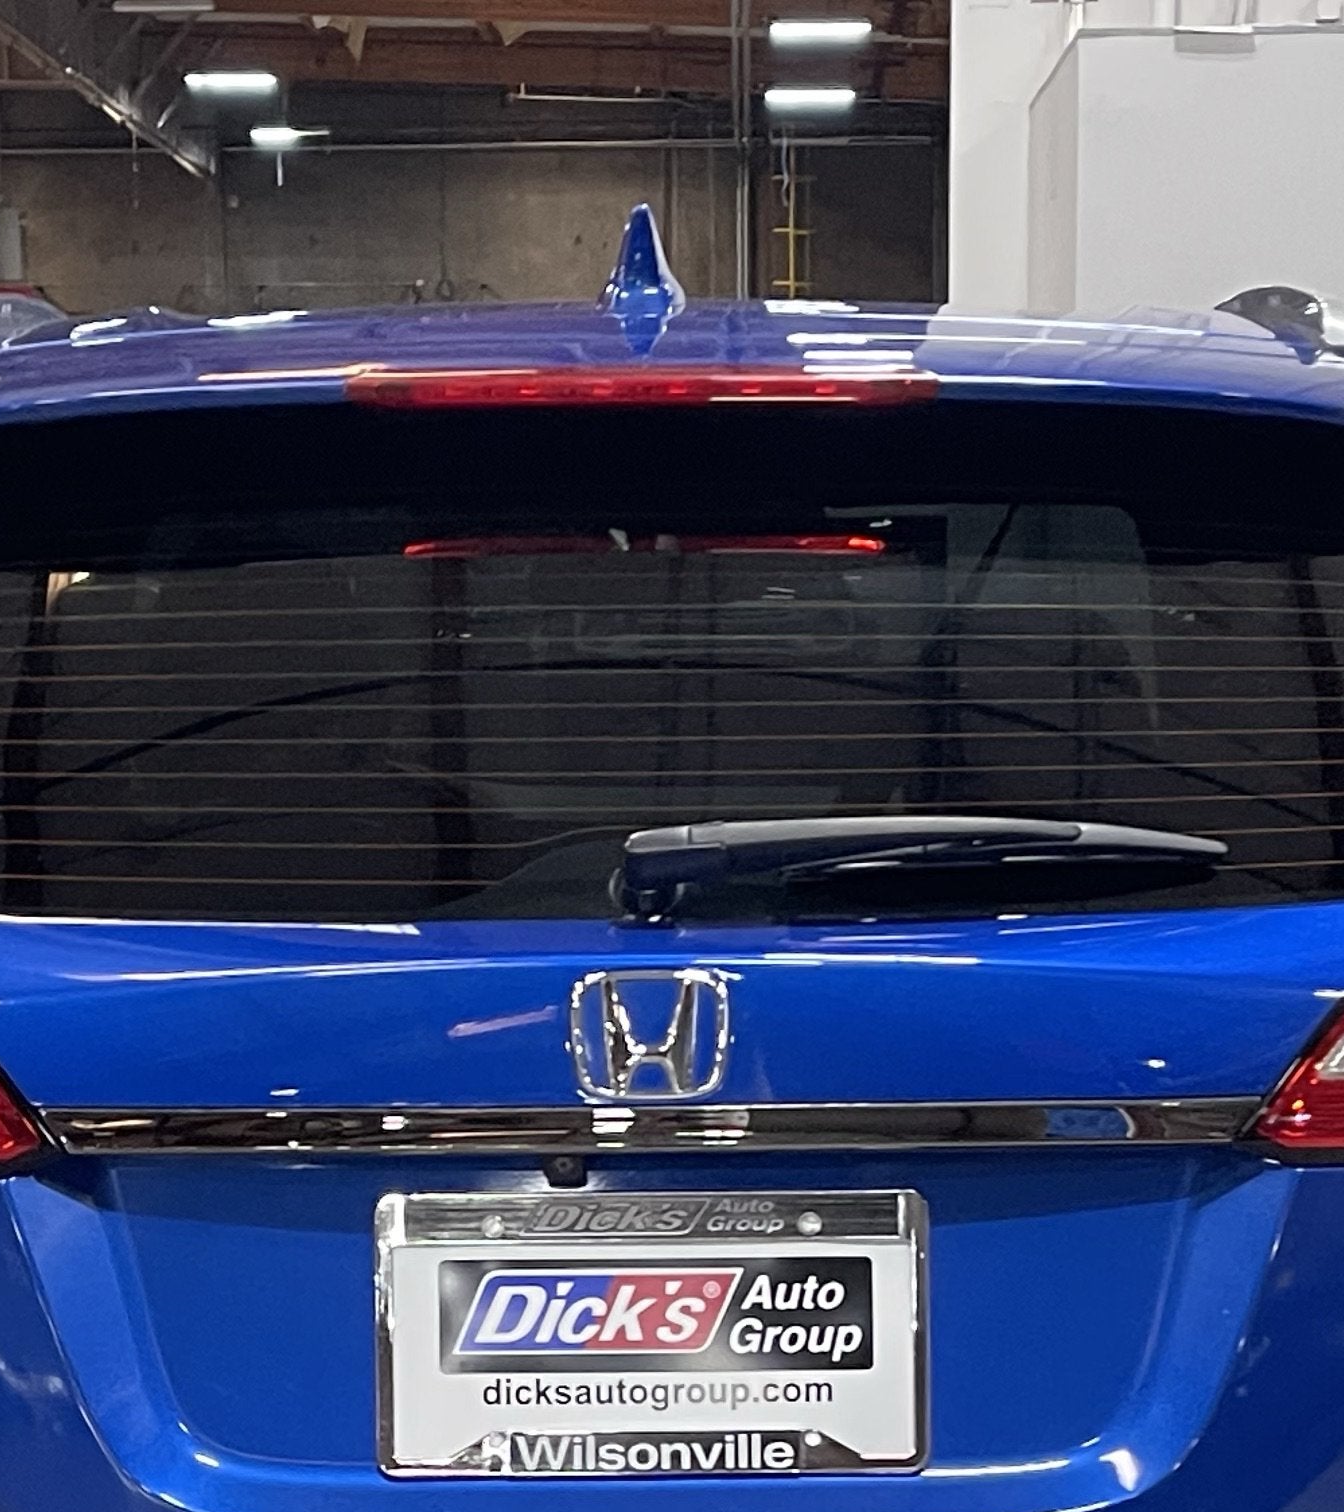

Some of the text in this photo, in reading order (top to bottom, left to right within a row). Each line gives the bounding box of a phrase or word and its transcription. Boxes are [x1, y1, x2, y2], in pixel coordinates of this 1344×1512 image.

[533, 1203, 689, 1233] Dick's
[713, 1199, 774, 1214] Auto
[707, 1215, 785, 1234] Group
[739, 1274, 845, 1311] Auto
[473, 1280, 706, 1345] Dick's
[729, 1318, 863, 1362] Group
[482, 1379, 834, 1411] dicksautogroup.com
[514, 1433, 796, 1471] Wilsonville
